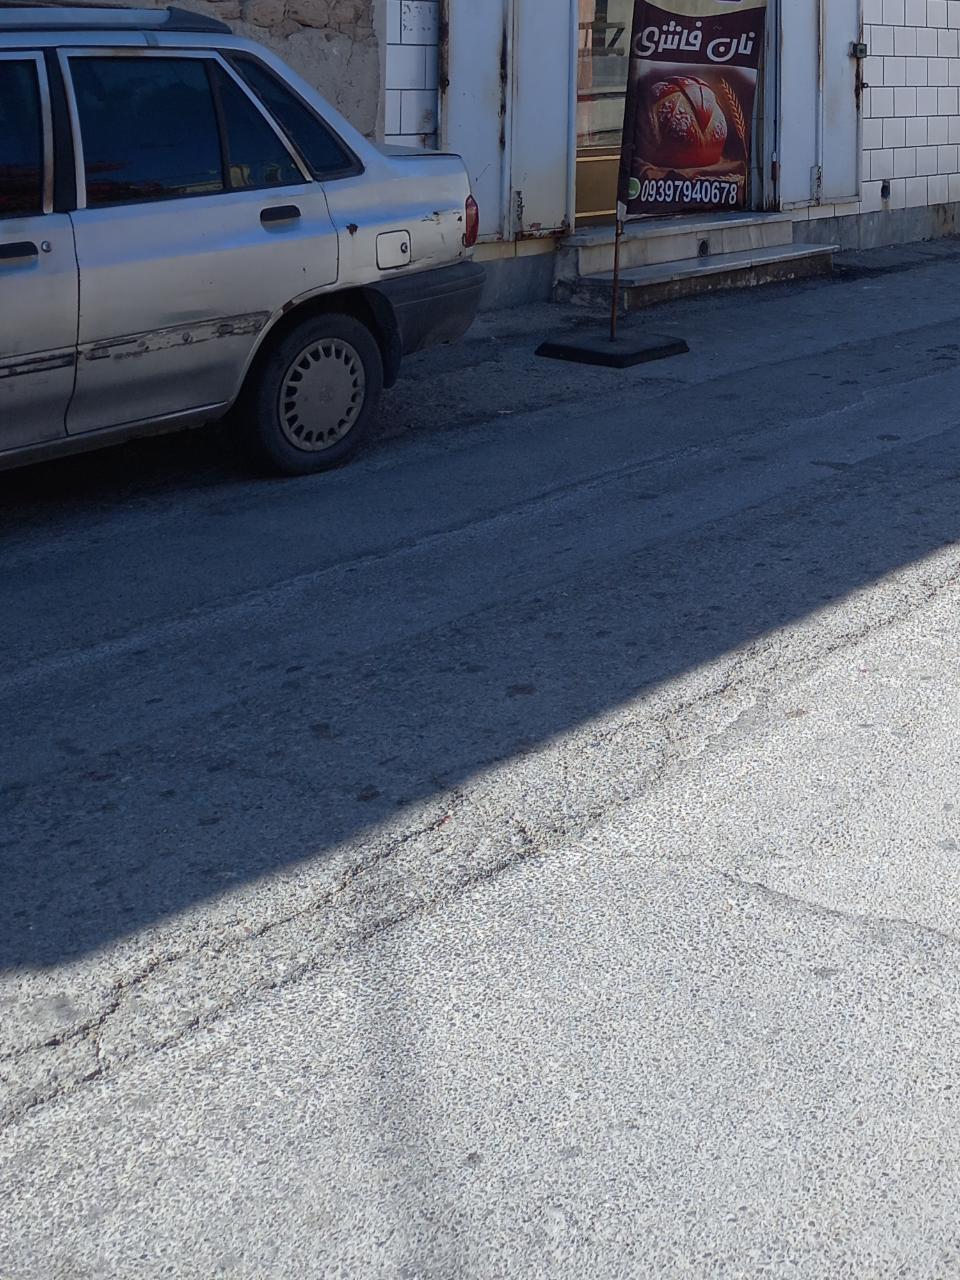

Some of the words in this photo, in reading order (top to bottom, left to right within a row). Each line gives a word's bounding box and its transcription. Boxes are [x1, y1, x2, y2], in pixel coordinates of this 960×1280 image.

[633, 20, 703, 58] فانتزی
[706, 31, 756, 62] نان
[640, 179, 738, 205] 09397940678
